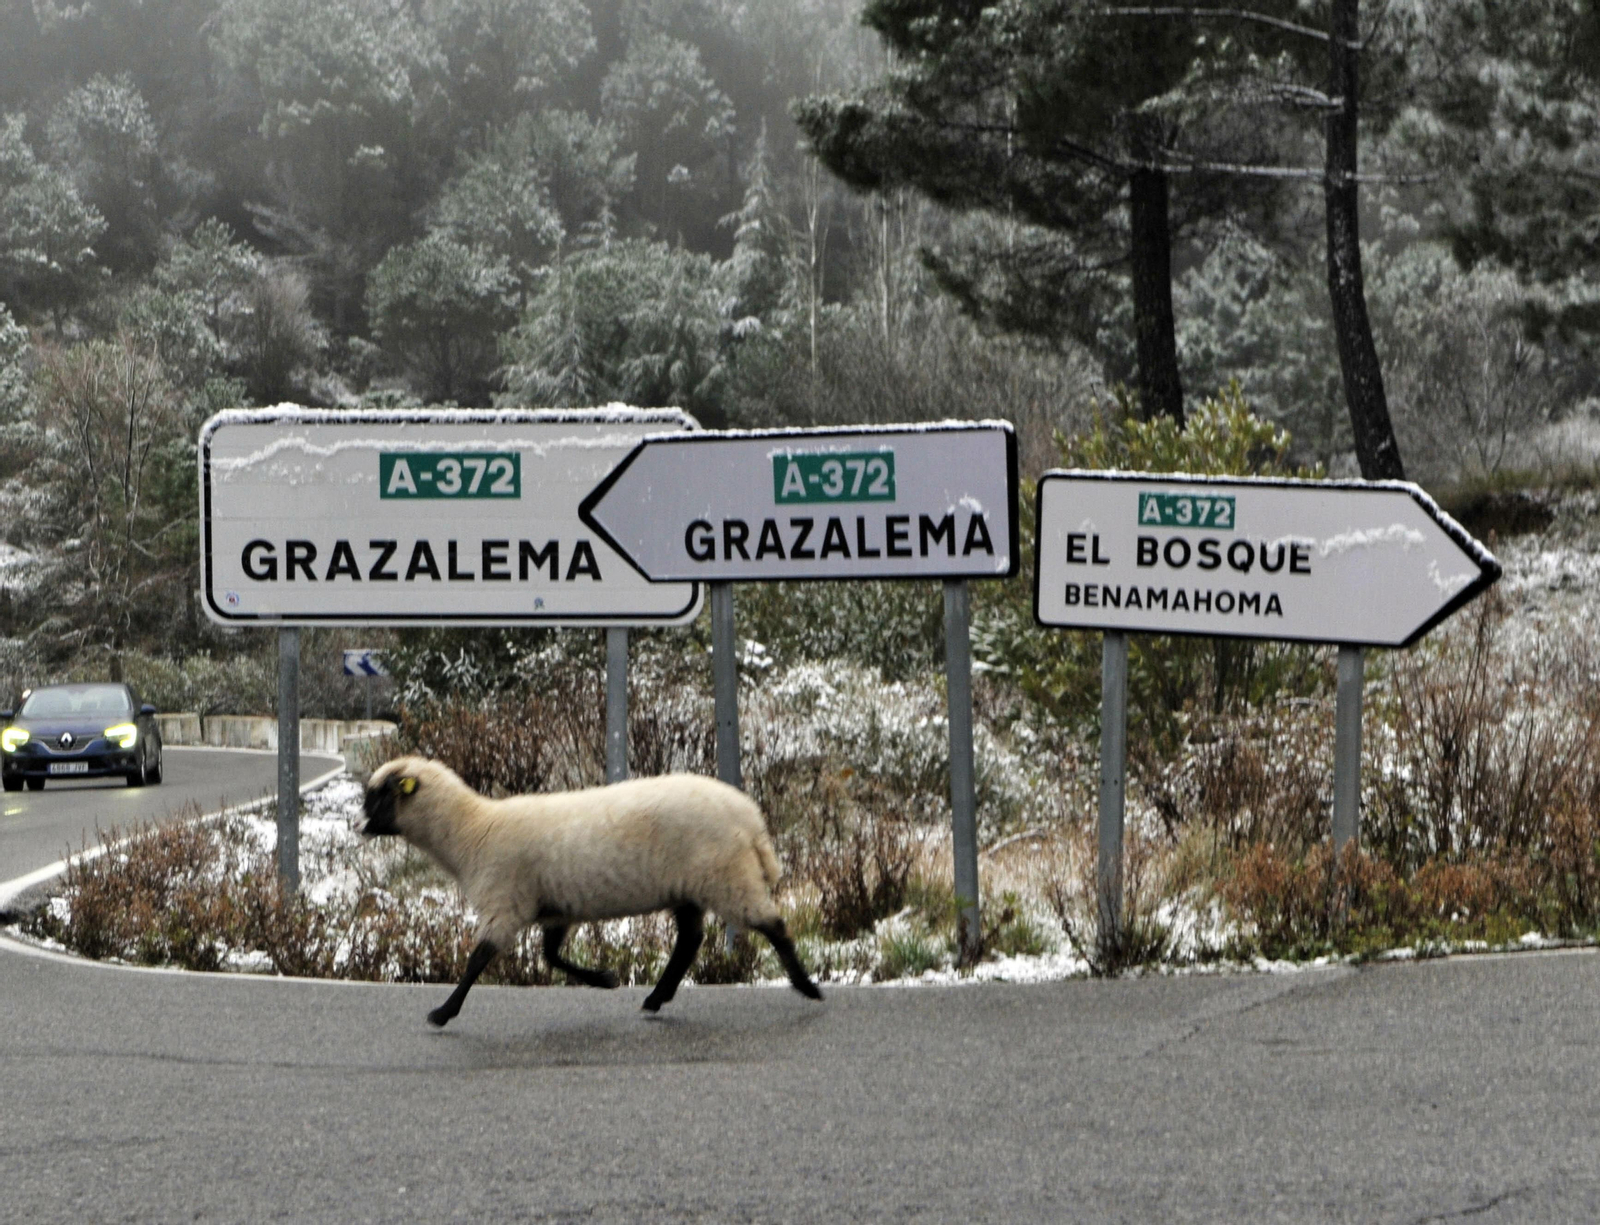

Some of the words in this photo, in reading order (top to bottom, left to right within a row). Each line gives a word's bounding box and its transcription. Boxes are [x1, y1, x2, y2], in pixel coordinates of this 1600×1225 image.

[387, 457, 515, 494] A-372
[781, 458, 890, 498] A-372
[1142, 498, 1232, 527] A-372
[684, 513, 996, 562] GRAZALEMA
[1065, 532, 1111, 565] EL
[1136, 535, 1312, 575] BOSQUE
[241, 539, 603, 581] GRAZALEMA
[1064, 583, 1284, 616] BENAMAHOMA
